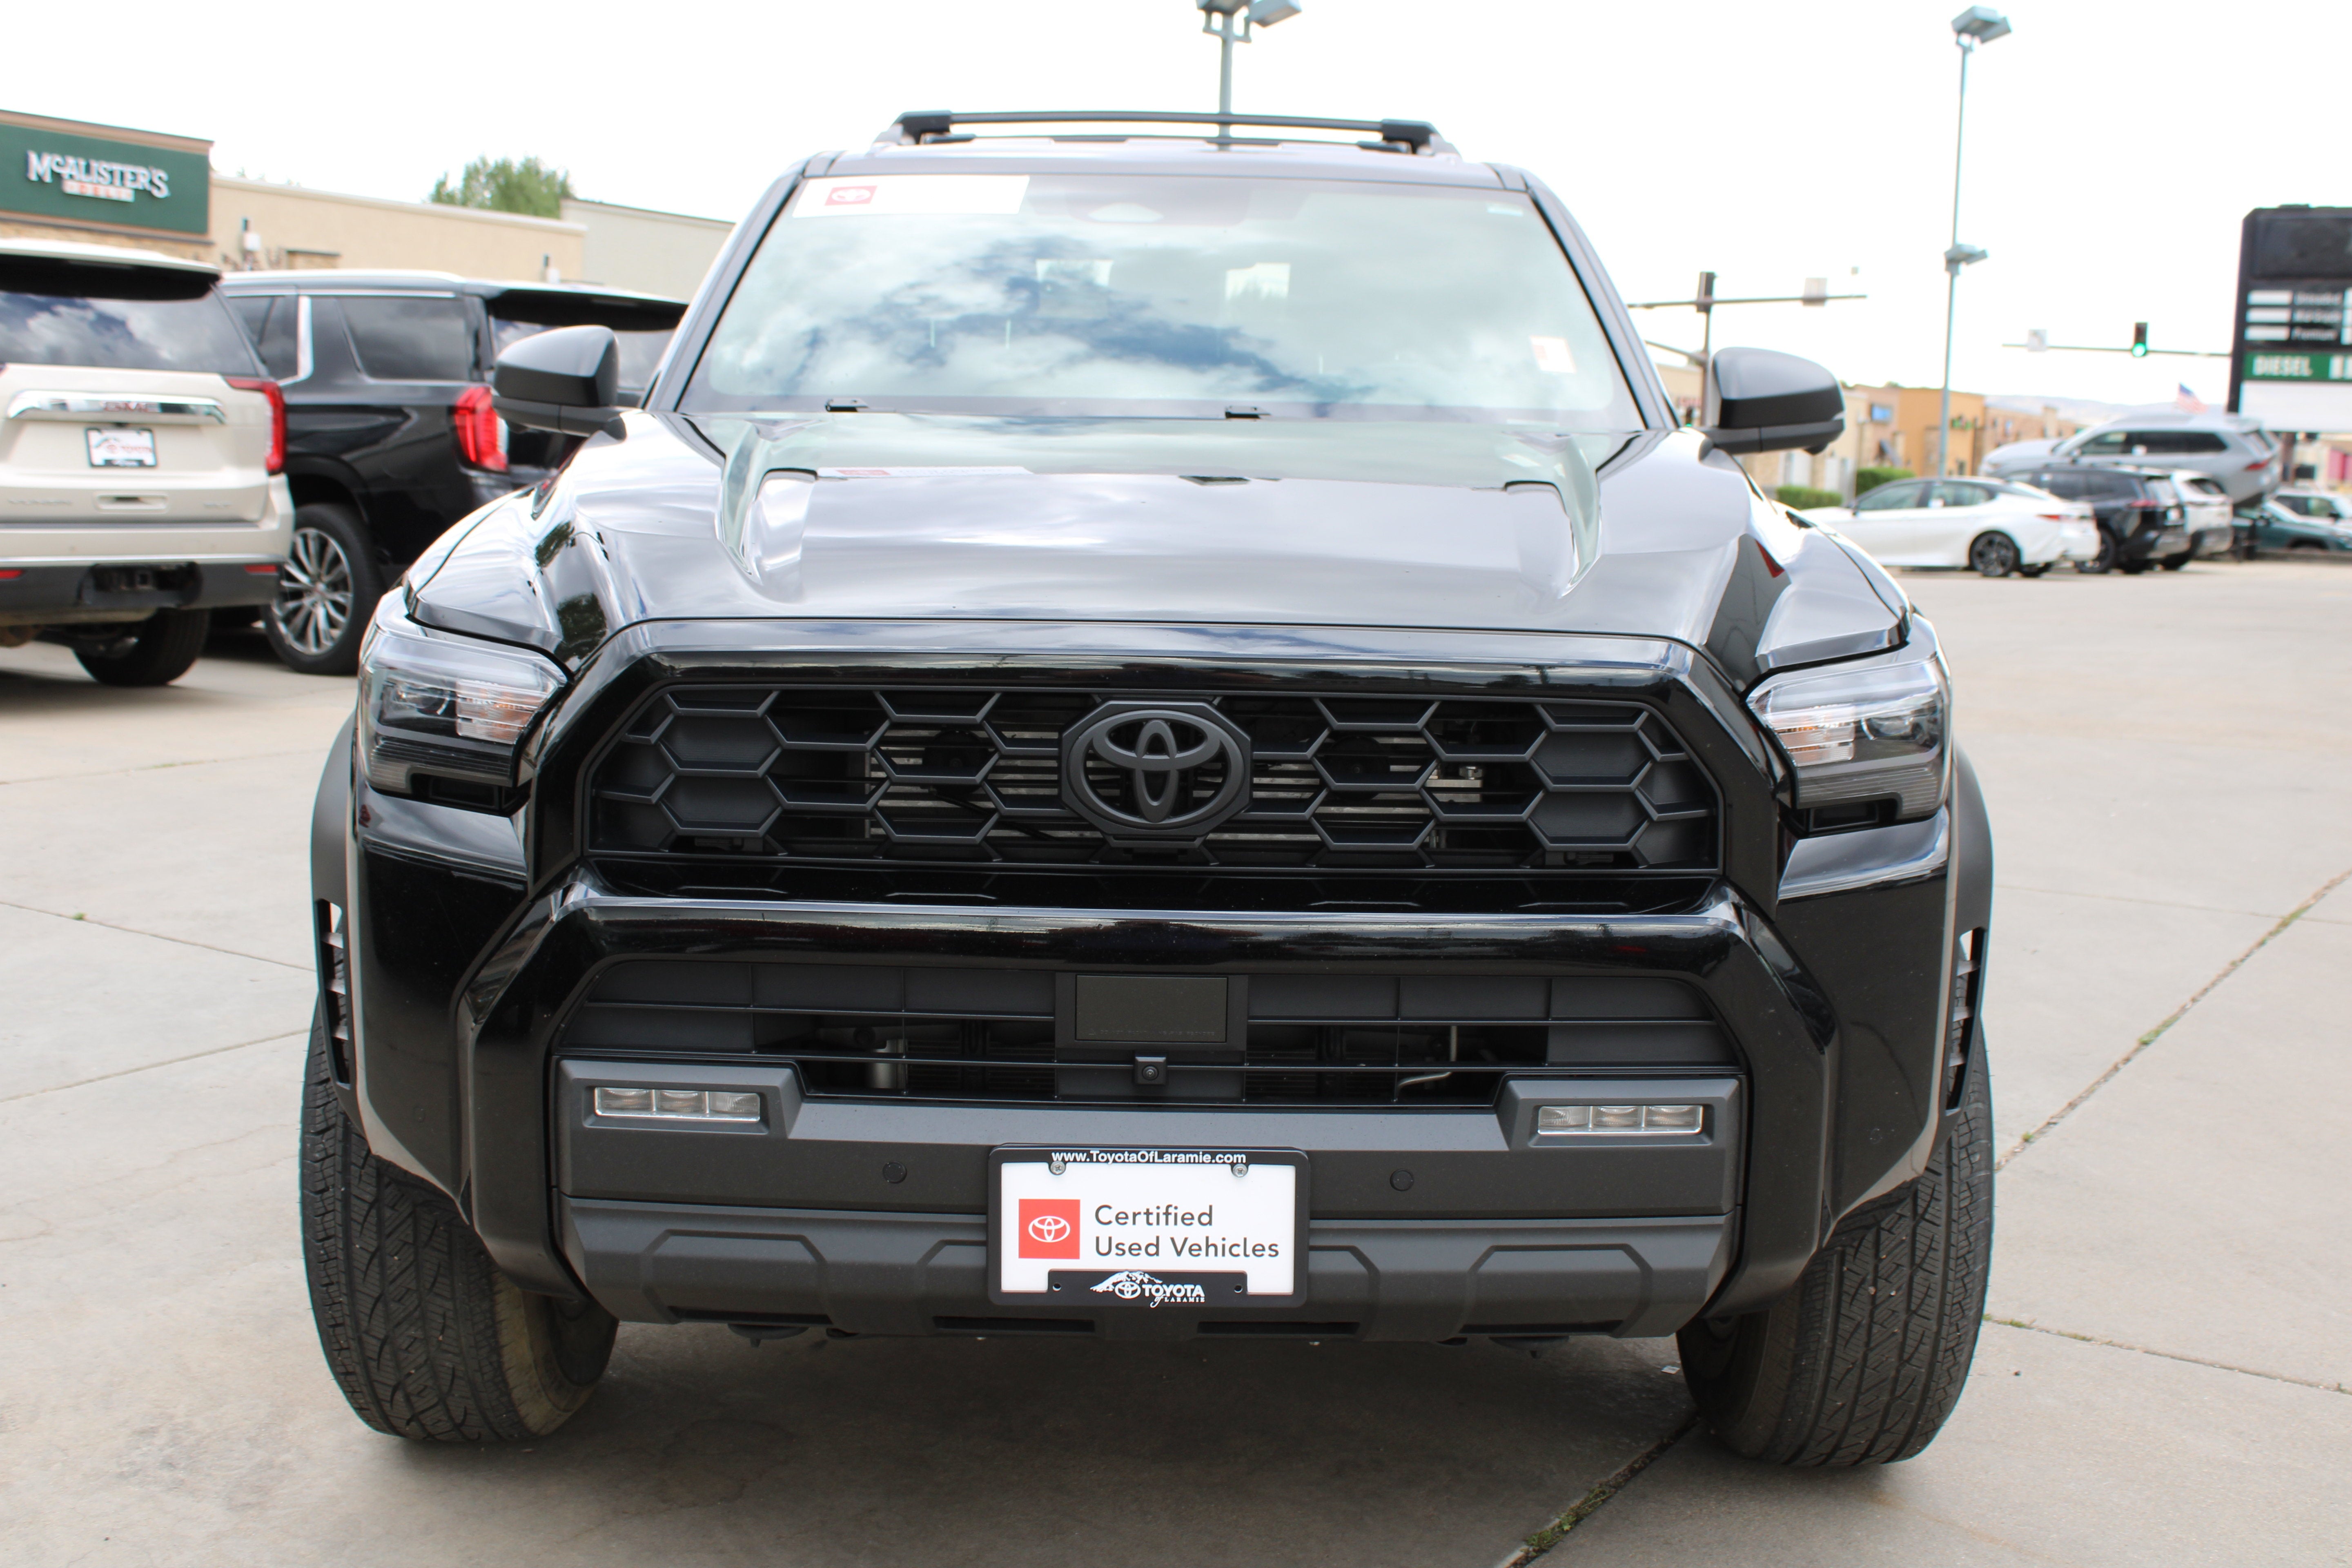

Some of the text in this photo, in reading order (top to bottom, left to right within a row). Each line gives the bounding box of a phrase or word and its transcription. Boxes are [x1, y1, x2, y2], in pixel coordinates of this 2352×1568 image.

[2252, 355, 2313, 376] DIESEL
[104, 402, 160, 412] GMC
[1051, 1150, 1247, 1164] www.ToyotaOfLaramie.com
[1095, 1204, 1212, 1226] Certified
[1096, 1236, 1279, 1257] Used Vehicles
[1142, 1284, 1205, 1297] TOYOTA
[1149, 1294, 1165, 1308] of
